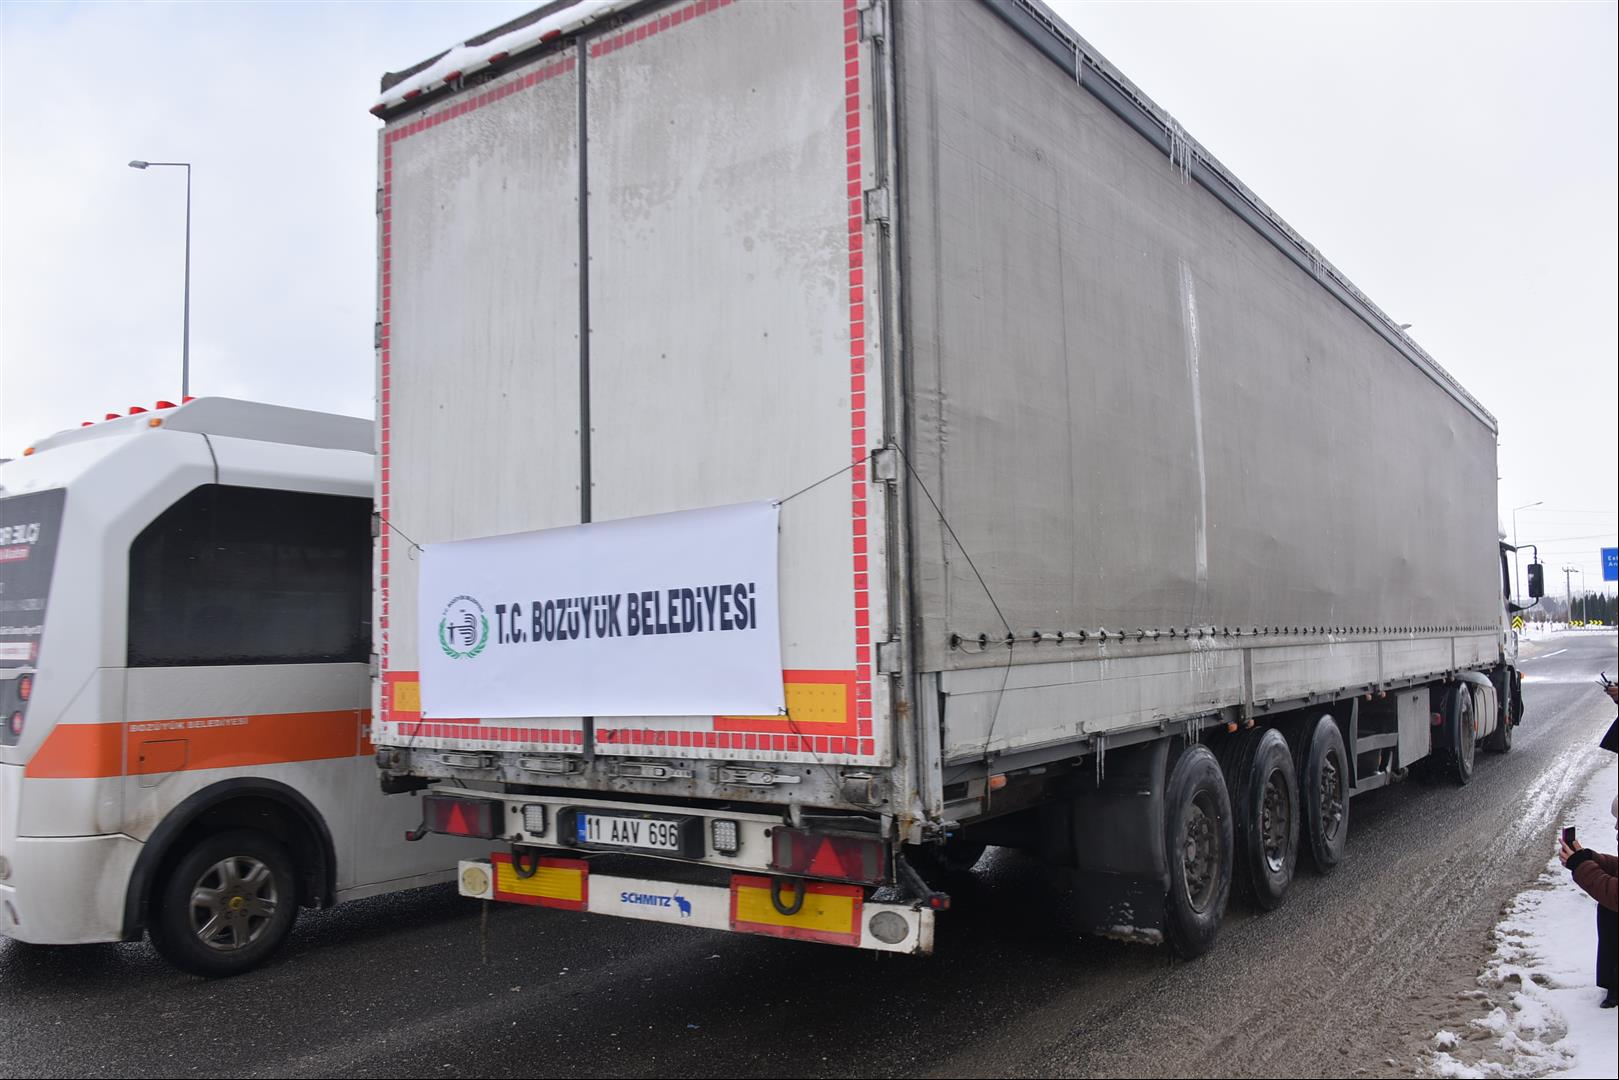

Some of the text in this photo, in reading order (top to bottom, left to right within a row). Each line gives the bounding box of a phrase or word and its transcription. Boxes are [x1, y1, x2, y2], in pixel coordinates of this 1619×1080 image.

[496, 604, 527, 644] T.C.
[532, 593, 622, 642] BOZÜYÜK
[627, 582, 756, 637] BELEDİYESİ
[588, 817, 678, 847] 11 AAV 696
[620, 892, 671, 907] SCHMITZ
